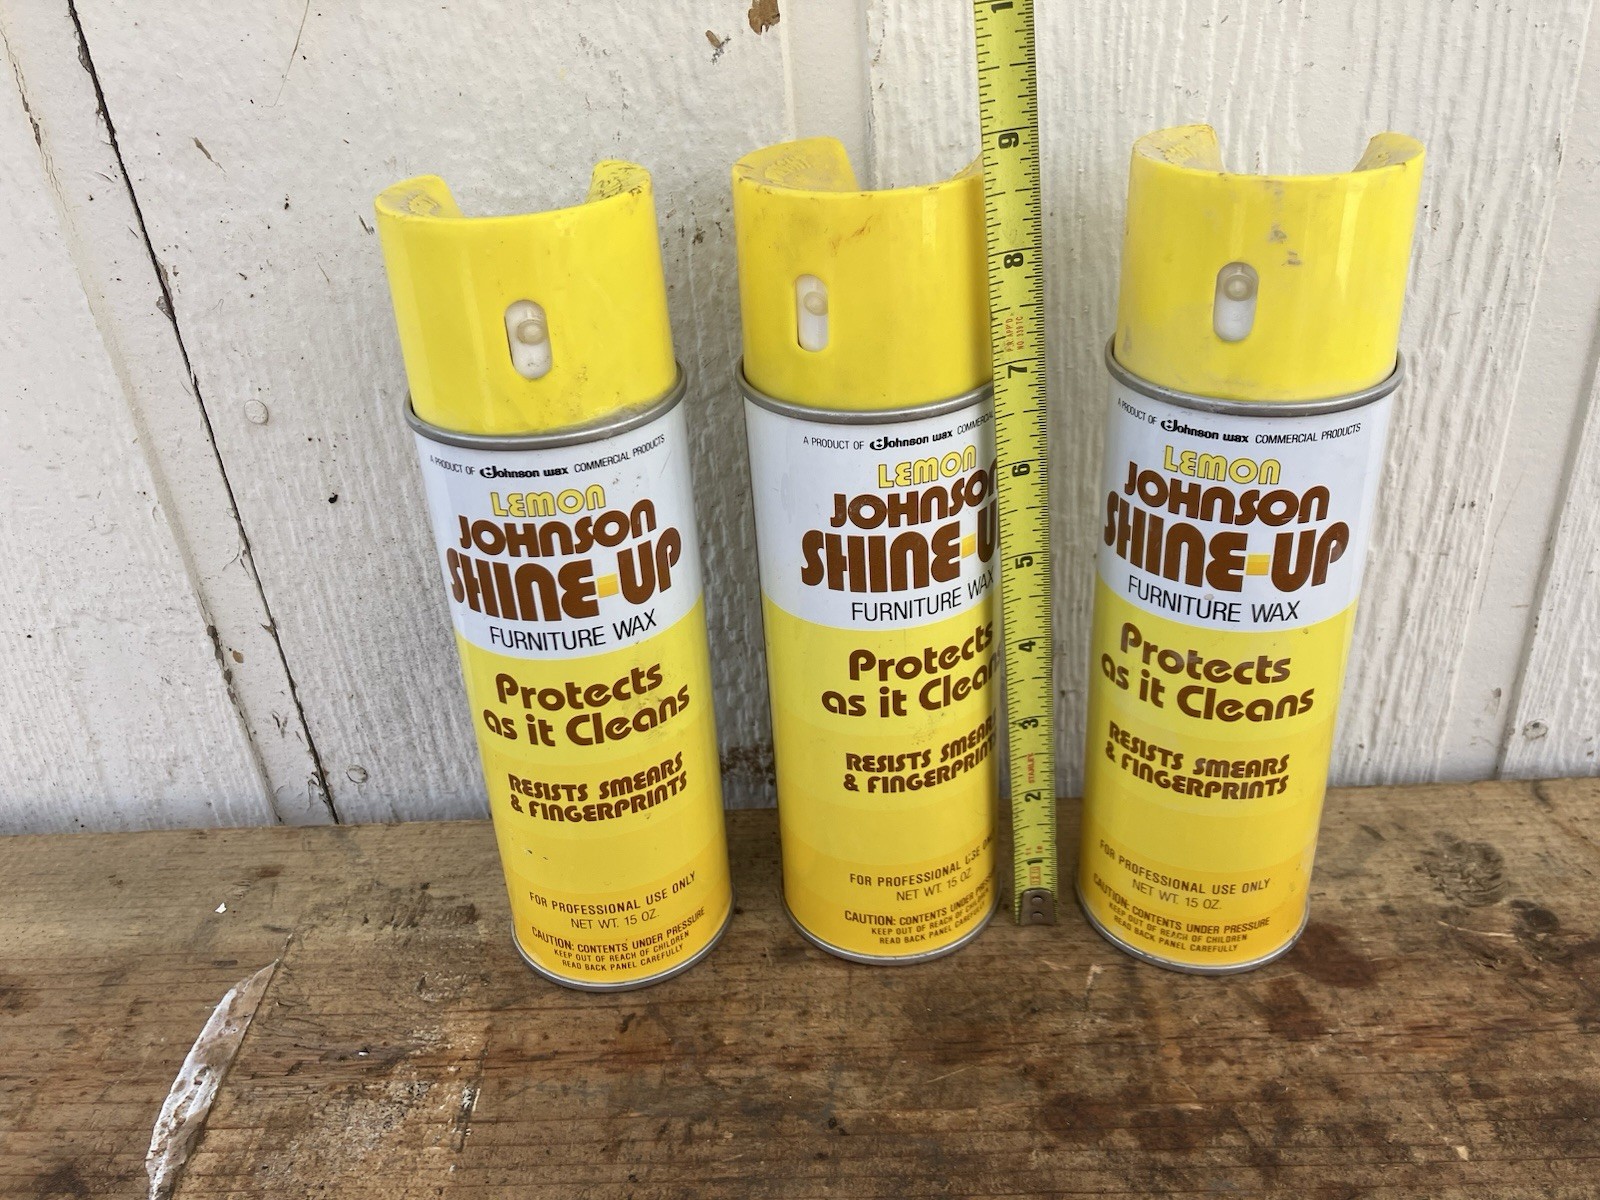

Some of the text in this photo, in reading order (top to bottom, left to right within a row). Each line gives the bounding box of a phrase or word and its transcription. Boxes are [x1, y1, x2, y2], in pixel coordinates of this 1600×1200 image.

[998, 131, 1020, 149] 9
[1003, 252, 1024, 269] 8
[1007, 364, 1027, 379] 7
[803, 436, 809, 445] A
[811, 437, 849, 450] PRODUCT
[853, 440, 865, 450] OF
[932, 429, 953, 442] wax
[1121, 401, 1146, 422] PRODUCT
[1148, 415, 1158, 426] OF
[1222, 432, 1249, 443] wax
[1255, 432, 1318, 444] COMMERCIAL
[1320, 422, 1361, 441] PRODUCTS
[435, 458, 463, 474] PRODUCT
[466, 466, 475, 476] OF
[543, 467, 569, 478] wax
[574, 448, 630, 473] COMMERCIAL
[632, 434, 665, 457] PRODUCTS
[878, 444, 977, 489] LEMON
[1011, 463, 1031, 477] 6
[1163, 445, 1281, 485] LEMON
[490, 483, 606, 517] LEMON
[1124, 461, 1330, 527] JOHNSON
[458, 498, 657, 557] JOHNSON
[800, 498, 1001, 593] SHINE-U
[1104, 490, 1350, 593] SHINE-UP
[446, 527, 682, 622] SHINE-UP
[1015, 555, 1034, 569] 5
[851, 565, 994, 621] FURNITURE WAX
[1128, 574, 1301, 623] FURNITURE WAX
[489, 608, 657, 651] FURNITURE WAX
[1018, 640, 1036, 653] 4
[849, 620, 993, 682] Protects
[1120, 622, 1291, 685] Protects
[495, 663, 663, 711] Protects
[821, 690, 867, 717] as
[879, 686, 907, 718] it
[1101, 653, 1315, 722] as it Cleans
[483, 684, 690, 747] as it Cleans
[1018, 718, 1039, 730] 3
[845, 748, 932, 773] RESISTS
[1105, 740, 1289, 800] & FINGERPRINTS
[1109, 720, 1290, 779] RESISTS SMEARS
[507, 751, 683, 802] RESISTS SMEARS
[510, 770, 687, 822] & FINGERPRINTS
[842, 773, 860, 792] &
[1024, 791, 1042, 803] 2
[849, 873, 872, 886] FOR
[877, 861, 961, 887] PROFESSIONAL
[964, 848, 981, 864] USE
[1027, 858, 1043, 866] 1
[1100, 839, 1271, 895] FOR PROFESSIONAL USE ONLY
[529, 871, 696, 915] FOR PROFESSIONAL USE ONLY
[844, 910, 896, 926] CAUTION:
[899, 907, 947, 926] CONTENTS
[950, 890, 974, 912] UNDER
[896, 888, 919, 901] NET
[946, 876, 958, 889] 15
[1093, 872, 1270, 934] CAUTION: CONTENTS UNDER PRESSURE
[1132, 879, 1155, 896] NET
[1185, 897, 1199, 908] 15
[1203, 898, 1222, 909] OZ.
[530, 906, 705, 954] CAUTION: CONTENTS UNDER PRESSURE
[570, 917, 594, 929] NET
[624, 912, 638, 926] 15
[641, 908, 660, 921] OZ.
[871, 927, 893, 936] KEEP
[895, 926, 913, 936] OUT
[916, 924, 926, 933] OF
[929, 915, 953, 929] REACH
[879, 936, 901, 945] READ
[904, 934, 926, 944] BACK
[929, 925, 952, 939] PANEL
[1109, 902, 1248, 944] KEEP OUT OF REACH OF CHILDREN
[1113, 915, 1238, 953] READ BACK PANEL CAREFULLY
[554, 930, 689, 963] KEEP OUT OF REACH OF CHILDREN
[562, 943, 684, 971] READ BACK PANEL CAREFULLY
